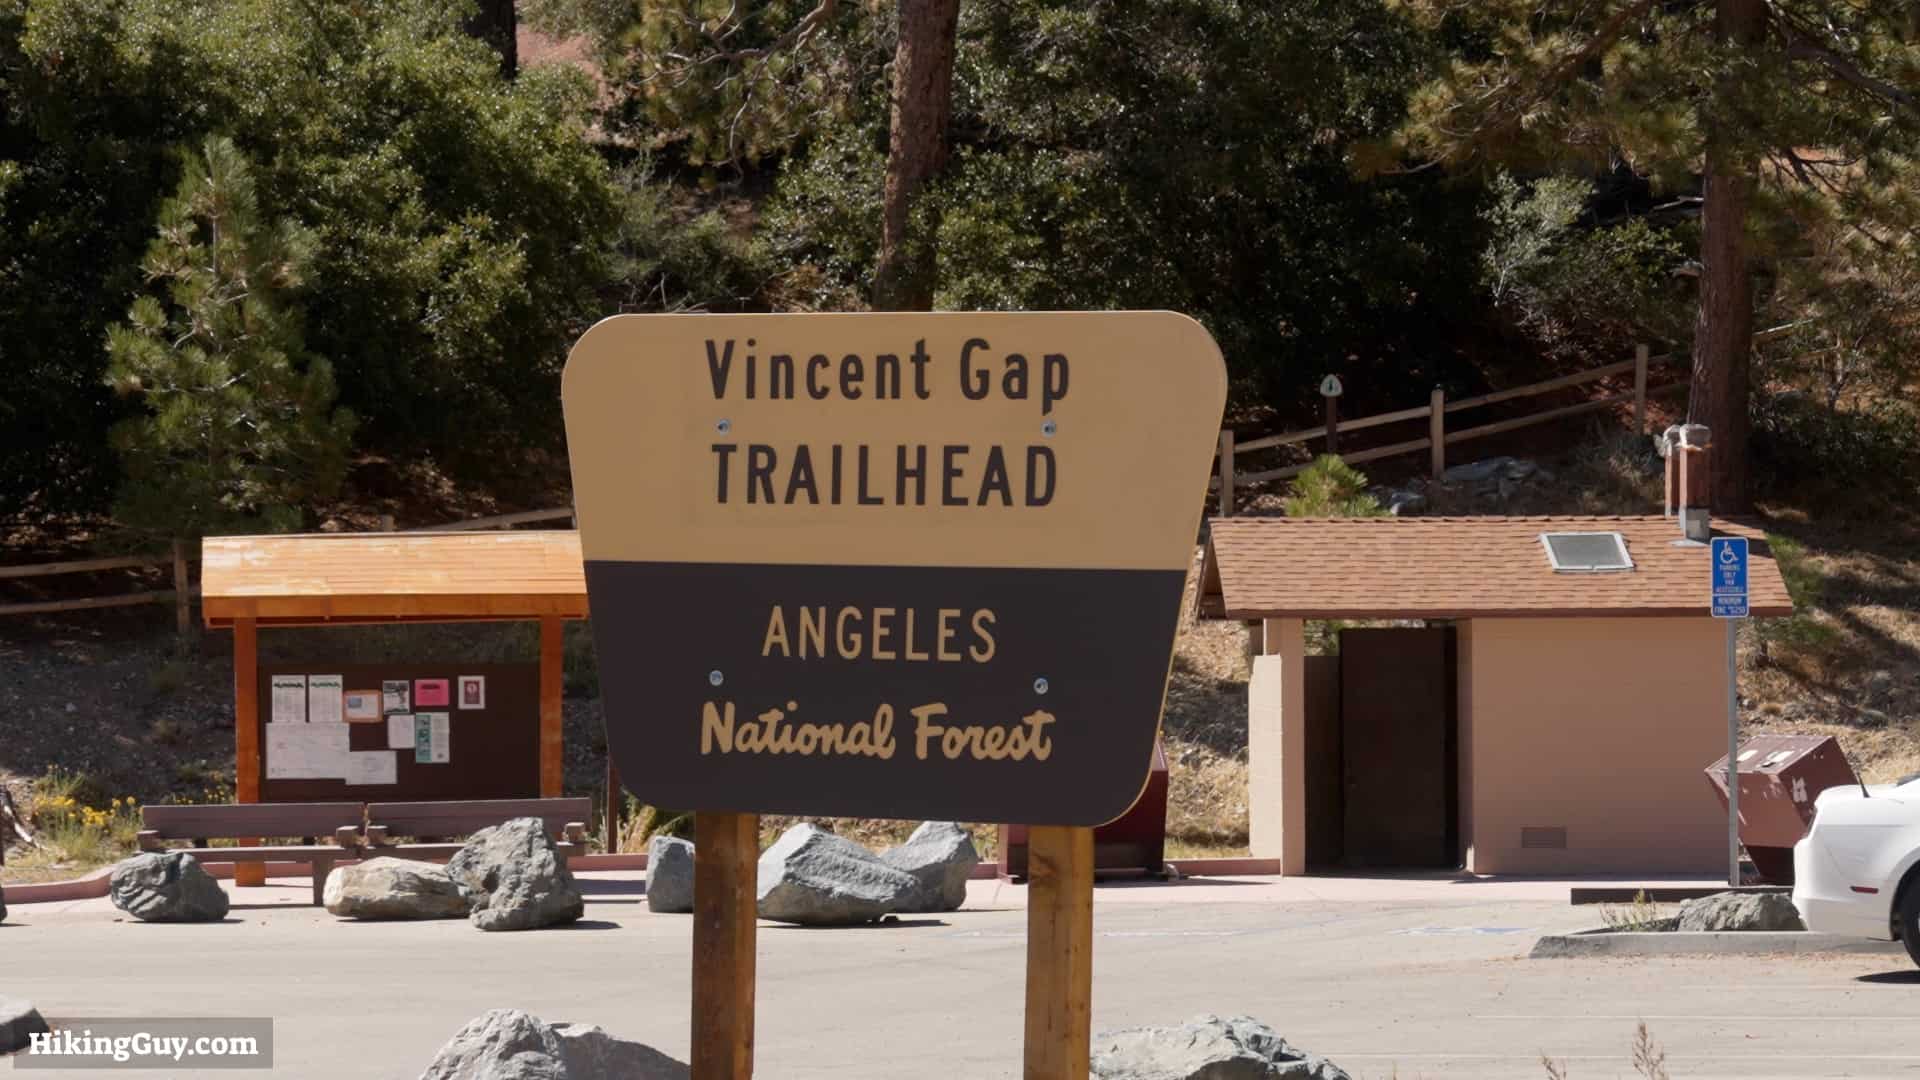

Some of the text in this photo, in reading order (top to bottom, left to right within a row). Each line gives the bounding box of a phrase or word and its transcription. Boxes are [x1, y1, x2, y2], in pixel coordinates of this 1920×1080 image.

[705, 337, 1070, 417] Vincent Gap
[711, 443, 1057, 507] TRAILHEAD
[762, 605, 996, 663] ANGELES
[701, 700, 1056, 762] National Forest
